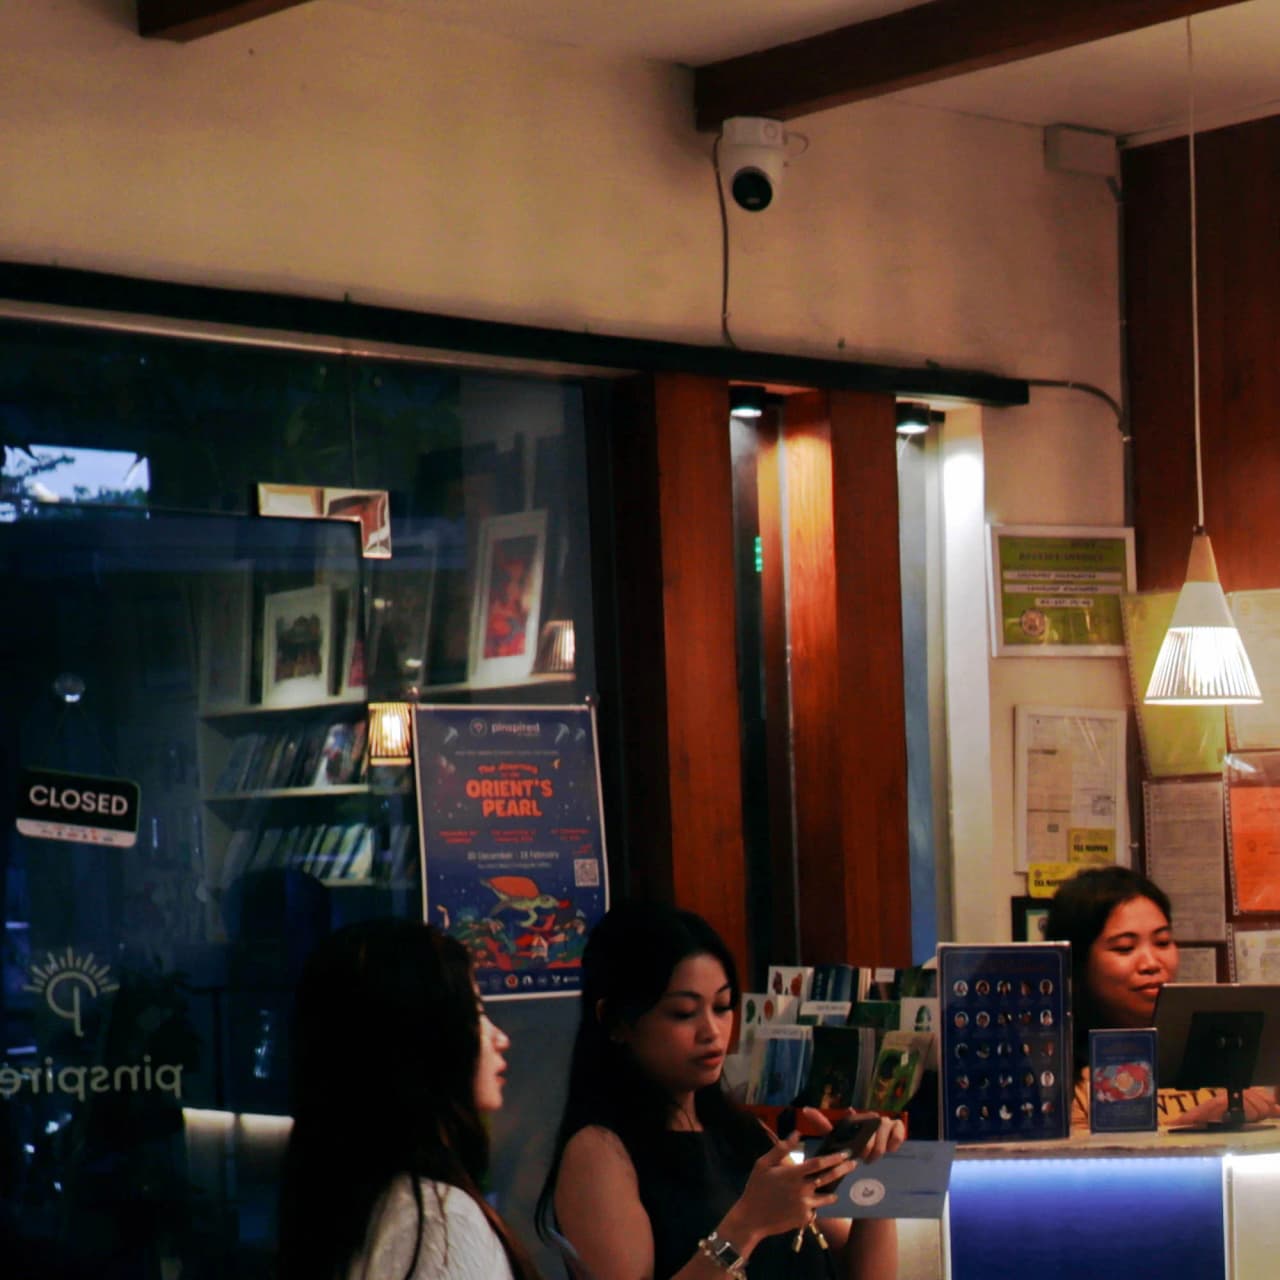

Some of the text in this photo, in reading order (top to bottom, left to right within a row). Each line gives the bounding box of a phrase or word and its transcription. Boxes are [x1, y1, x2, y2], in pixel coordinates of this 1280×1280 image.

[466, 779, 553, 798] ORIENT'S
[29, 784, 129, 817] CLOSED
[482, 799, 543, 818] PEARL
